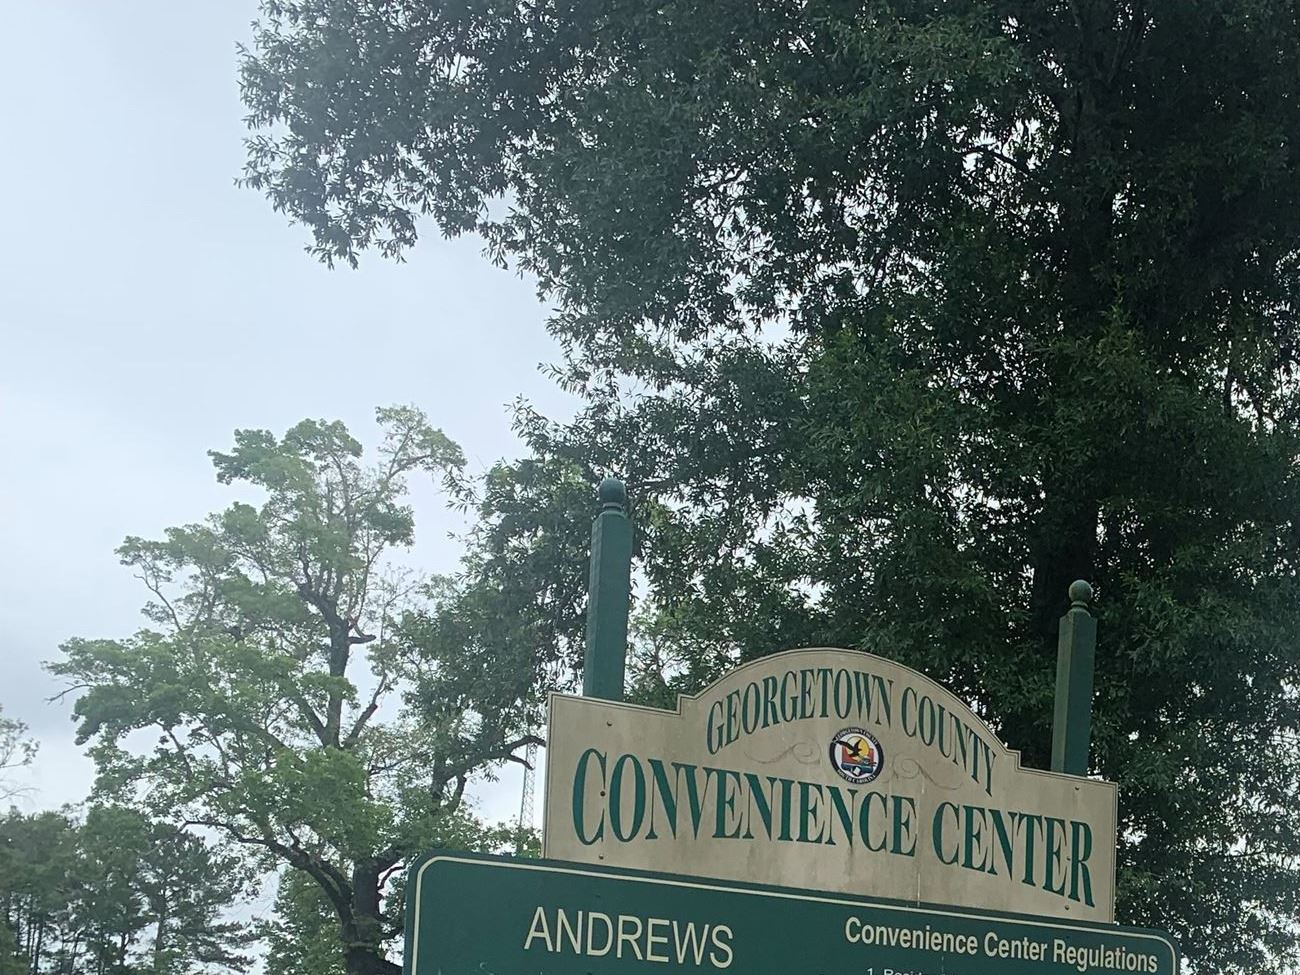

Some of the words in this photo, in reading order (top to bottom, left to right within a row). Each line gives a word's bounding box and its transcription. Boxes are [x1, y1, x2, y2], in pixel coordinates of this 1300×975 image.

[707, 668, 893, 755] GEORGETOWN
[901, 686, 996, 797] COUNTY
[572, 748, 917, 857] CONVENIENCE
[932, 801, 1096, 908] CENTER
[524, 906, 733, 968] ANDREWS
[845, 916, 978, 955] Convenience
[984, 932, 1048, 961] Center
[1053, 939, 1158, 973] Regulations
